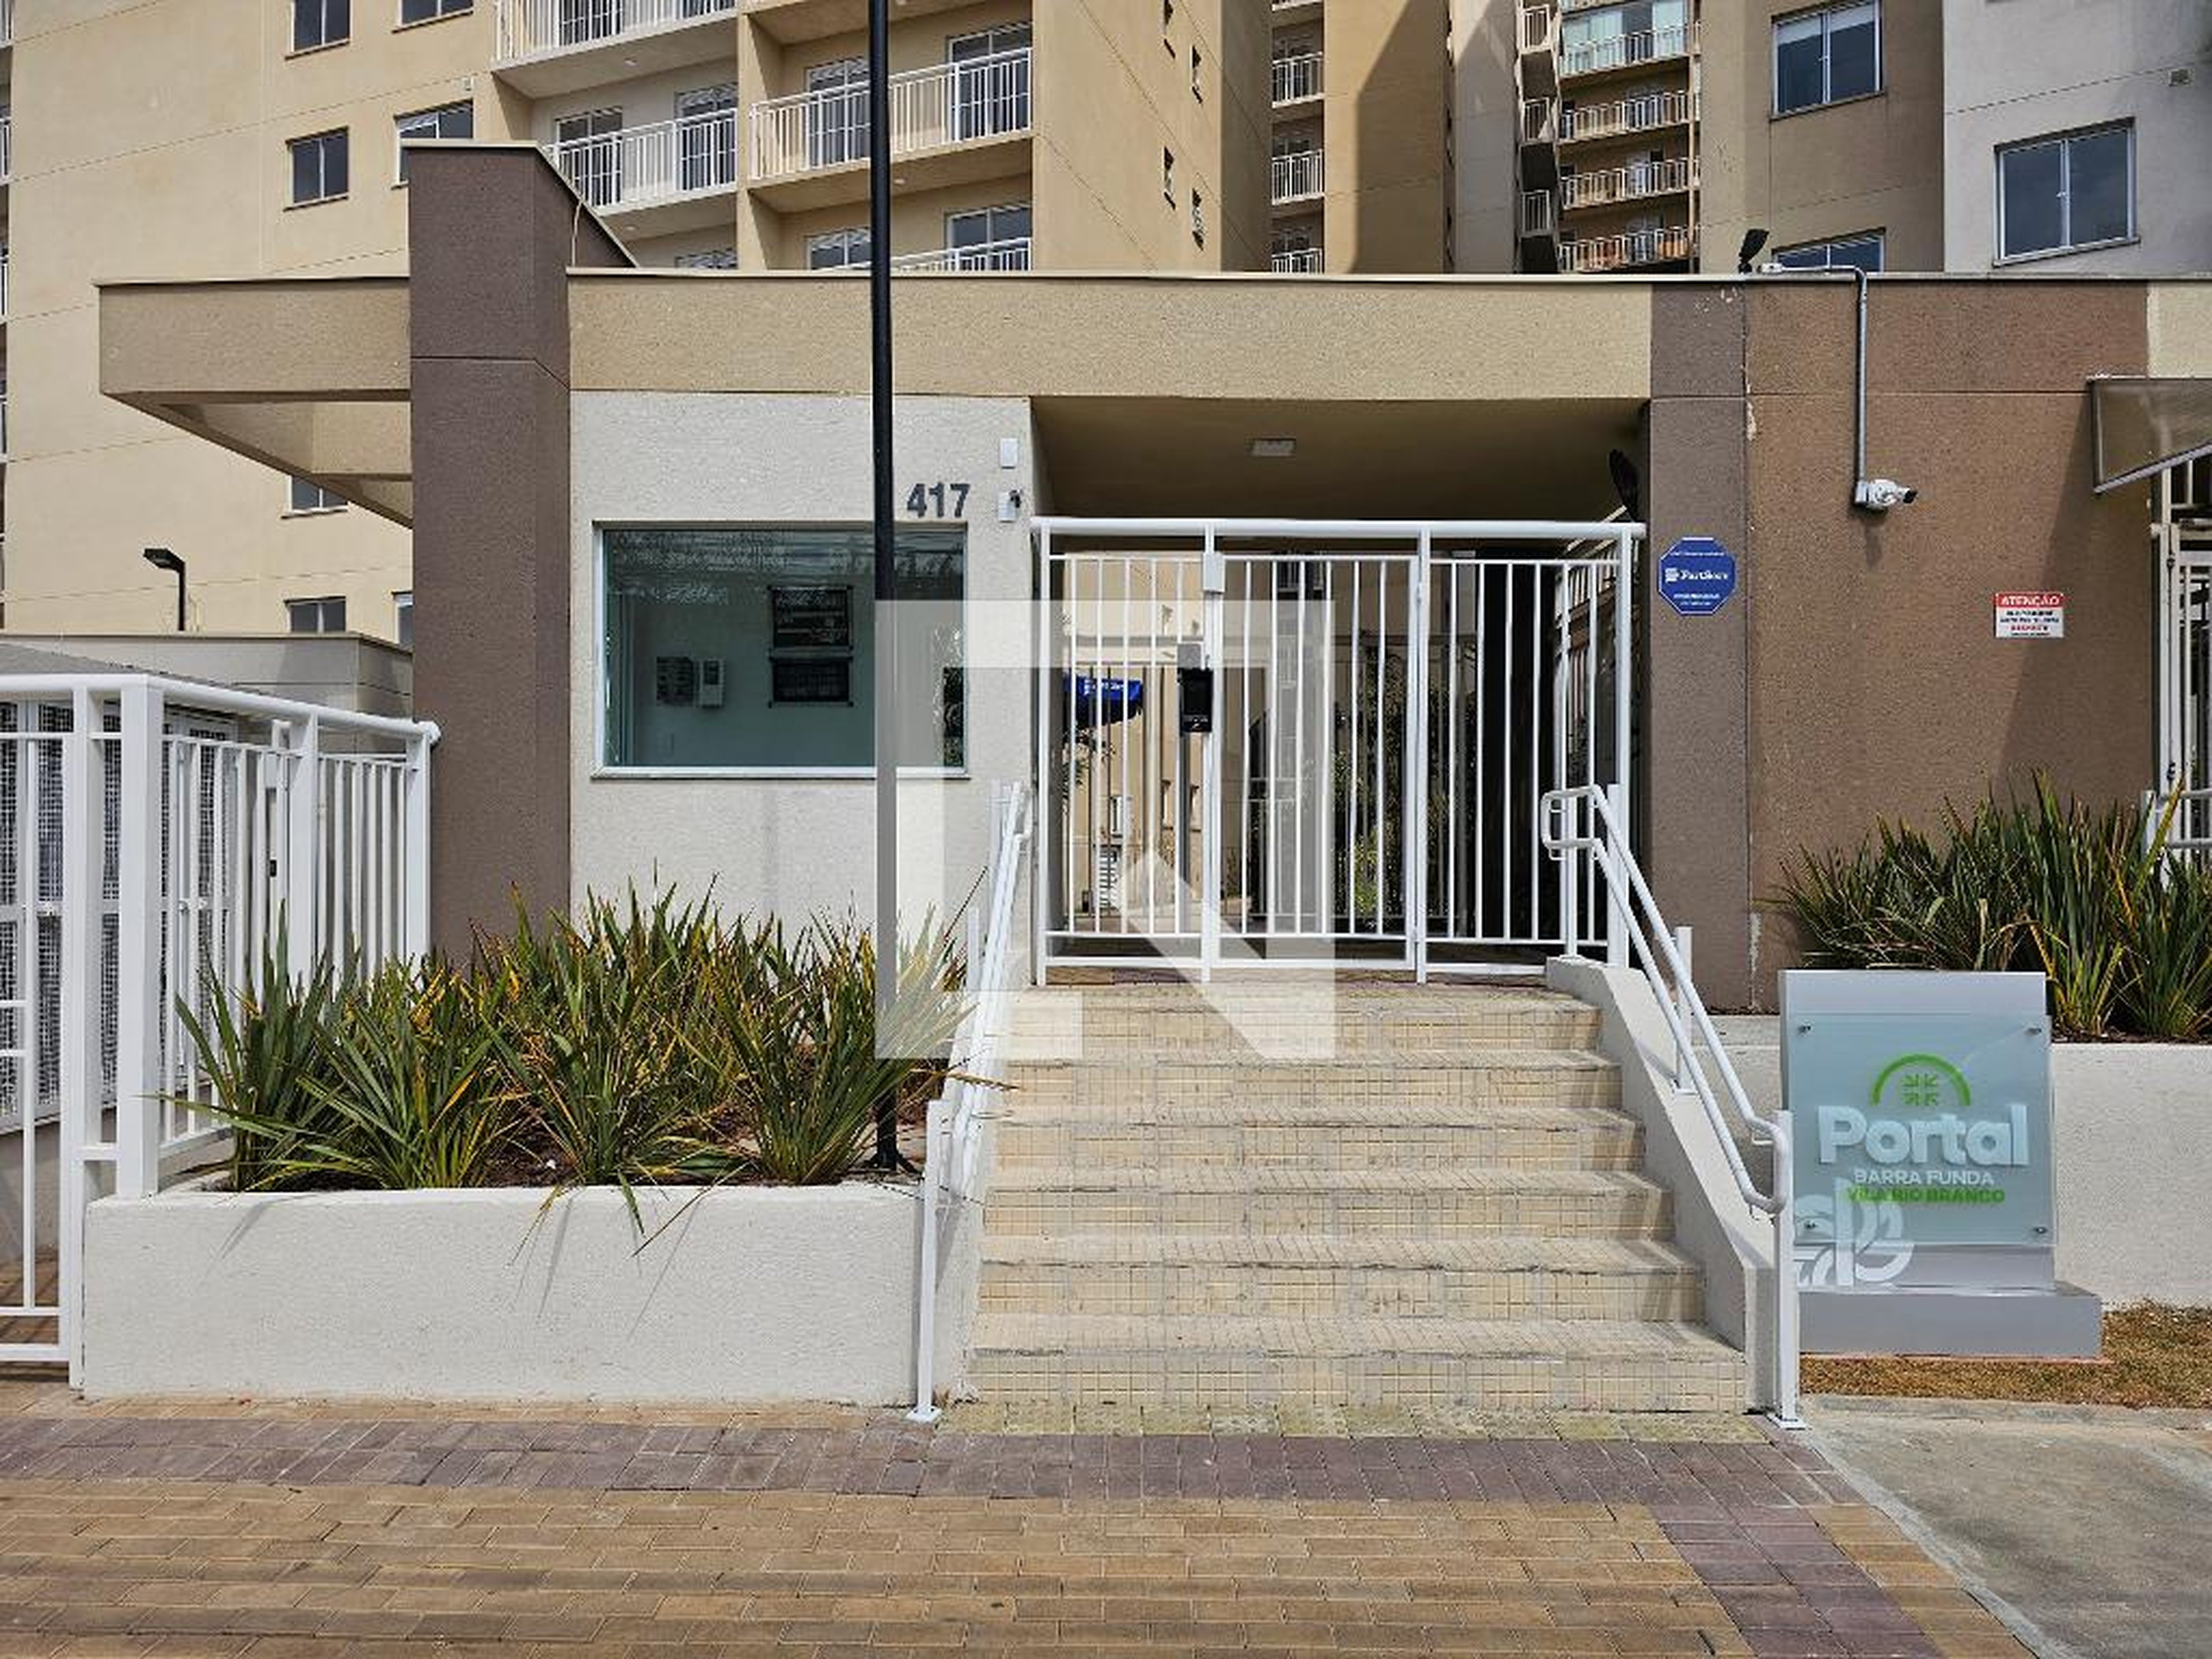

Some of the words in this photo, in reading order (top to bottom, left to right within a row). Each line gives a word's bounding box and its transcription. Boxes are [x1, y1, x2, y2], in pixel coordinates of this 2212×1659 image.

[907, 482, 970, 518] 417
[1818, 1104, 2029, 1166] Portal
[1854, 1169, 1922, 1185] BARRA
[1926, 1170, 1995, 1185] FUNDA
[1891, 1187, 1923, 1203] RIO
[1926, 1187, 2005, 1203] BRANCO
